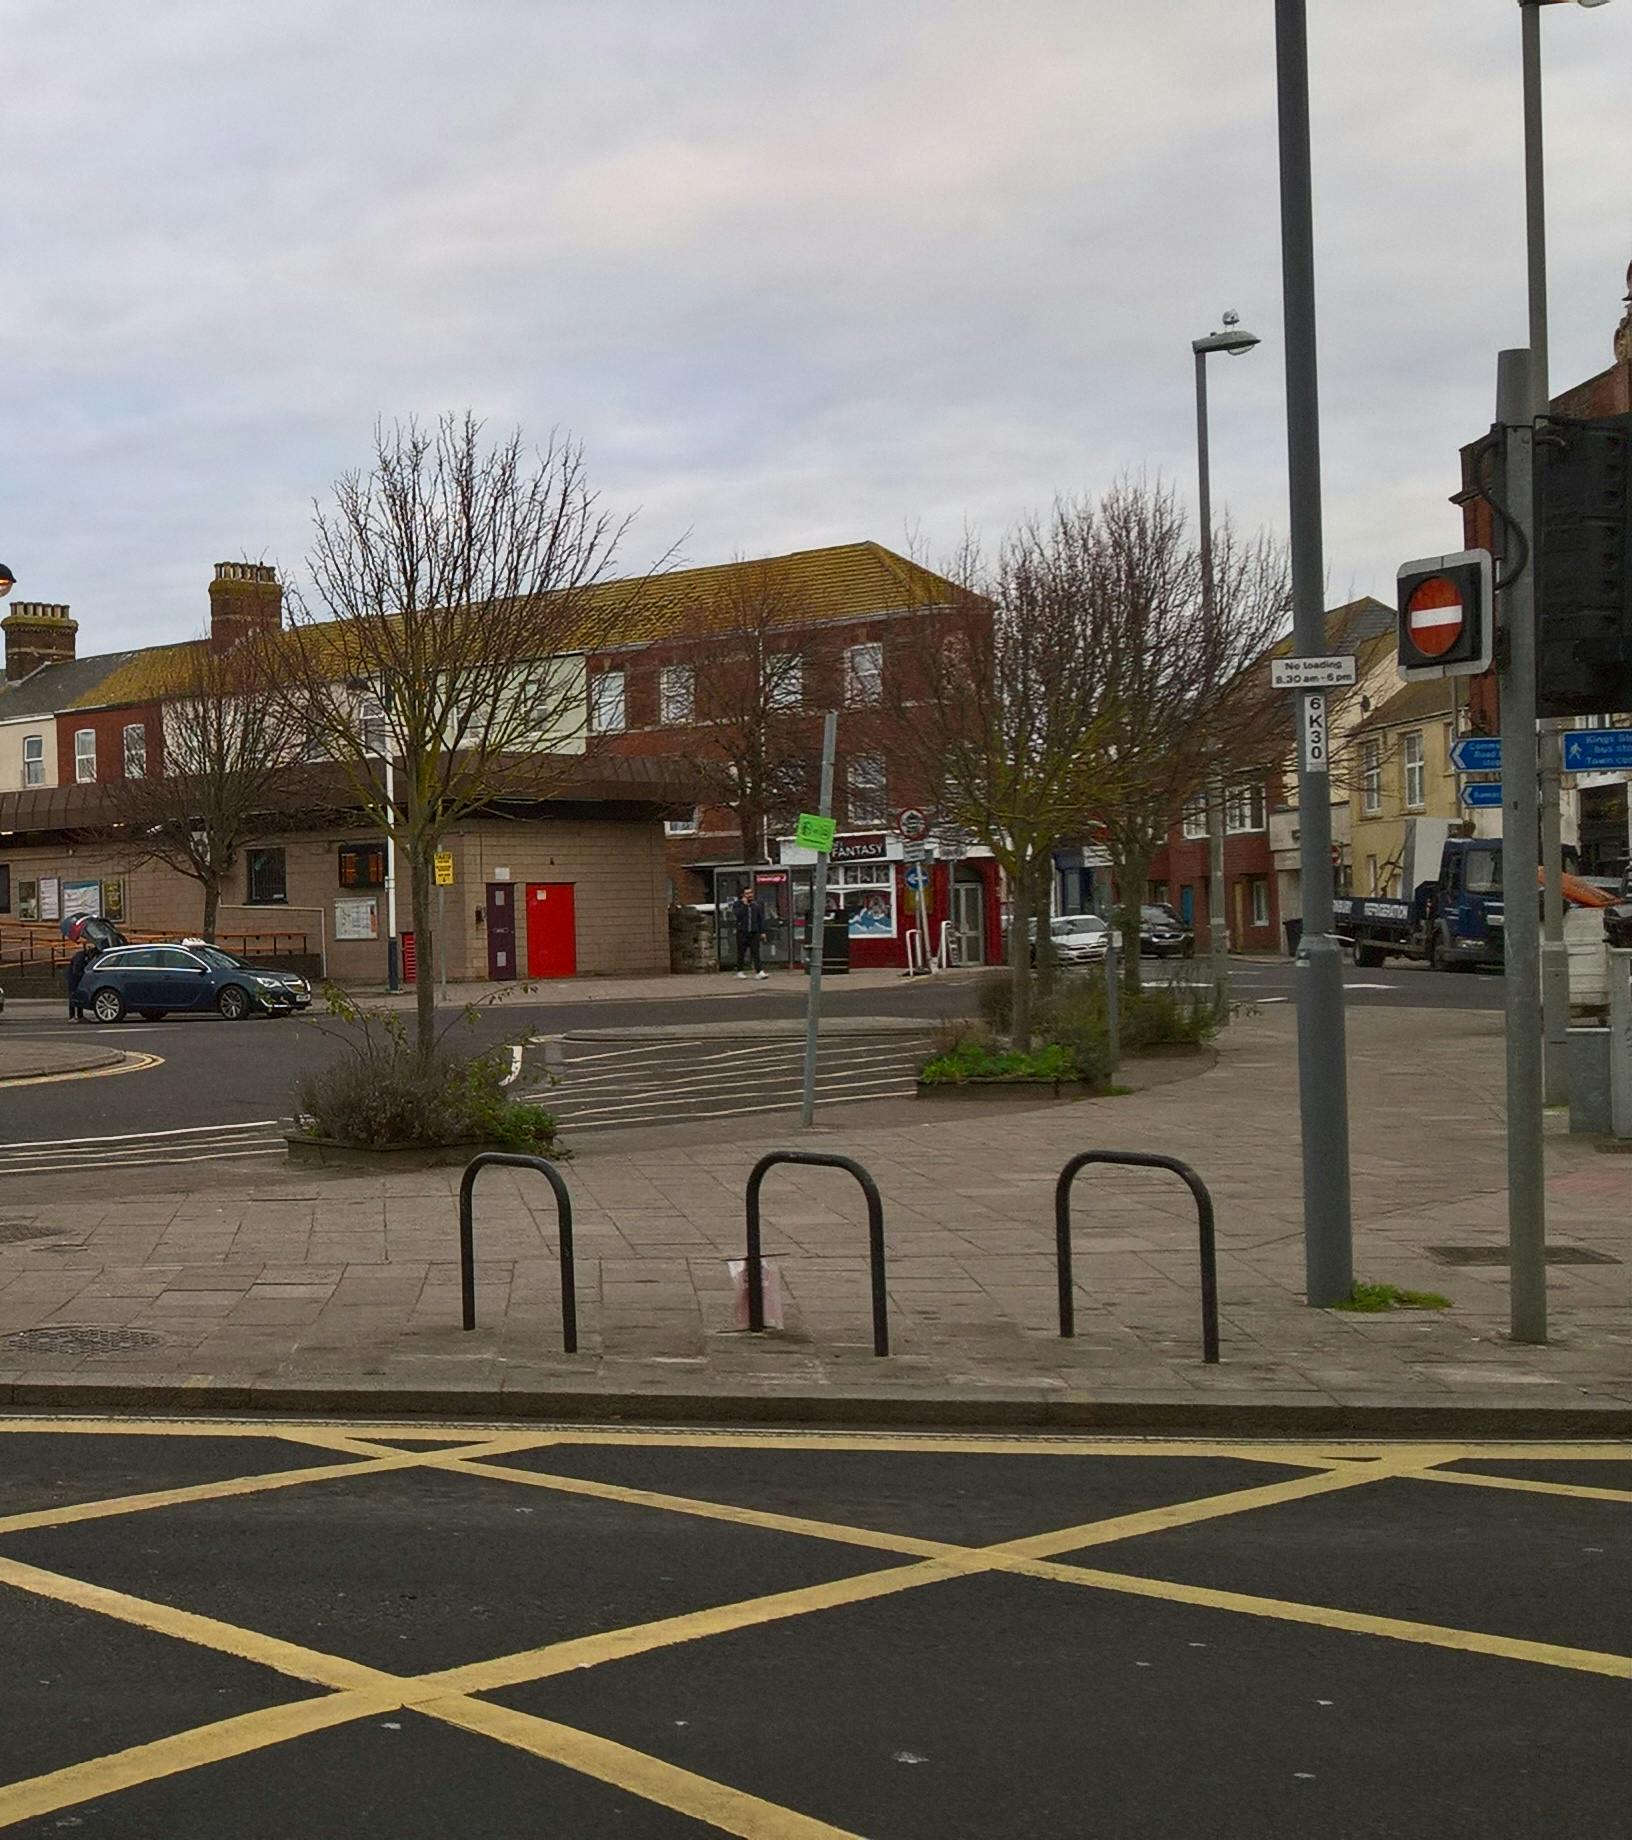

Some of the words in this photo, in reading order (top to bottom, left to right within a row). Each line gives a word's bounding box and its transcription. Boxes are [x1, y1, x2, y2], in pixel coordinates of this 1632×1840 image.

[1285, 662, 1301, 671] No
[1303, 661, 1343, 670] loading
[1275, 674, 1302, 684] 8.30
[1303, 675, 1320, 683] am
[1326, 672, 1334, 681] 6
[1335, 674, 1353, 683] pm
[1616, 743, 1632, 753] sto
[831, 842, 883, 858] FANTASY
